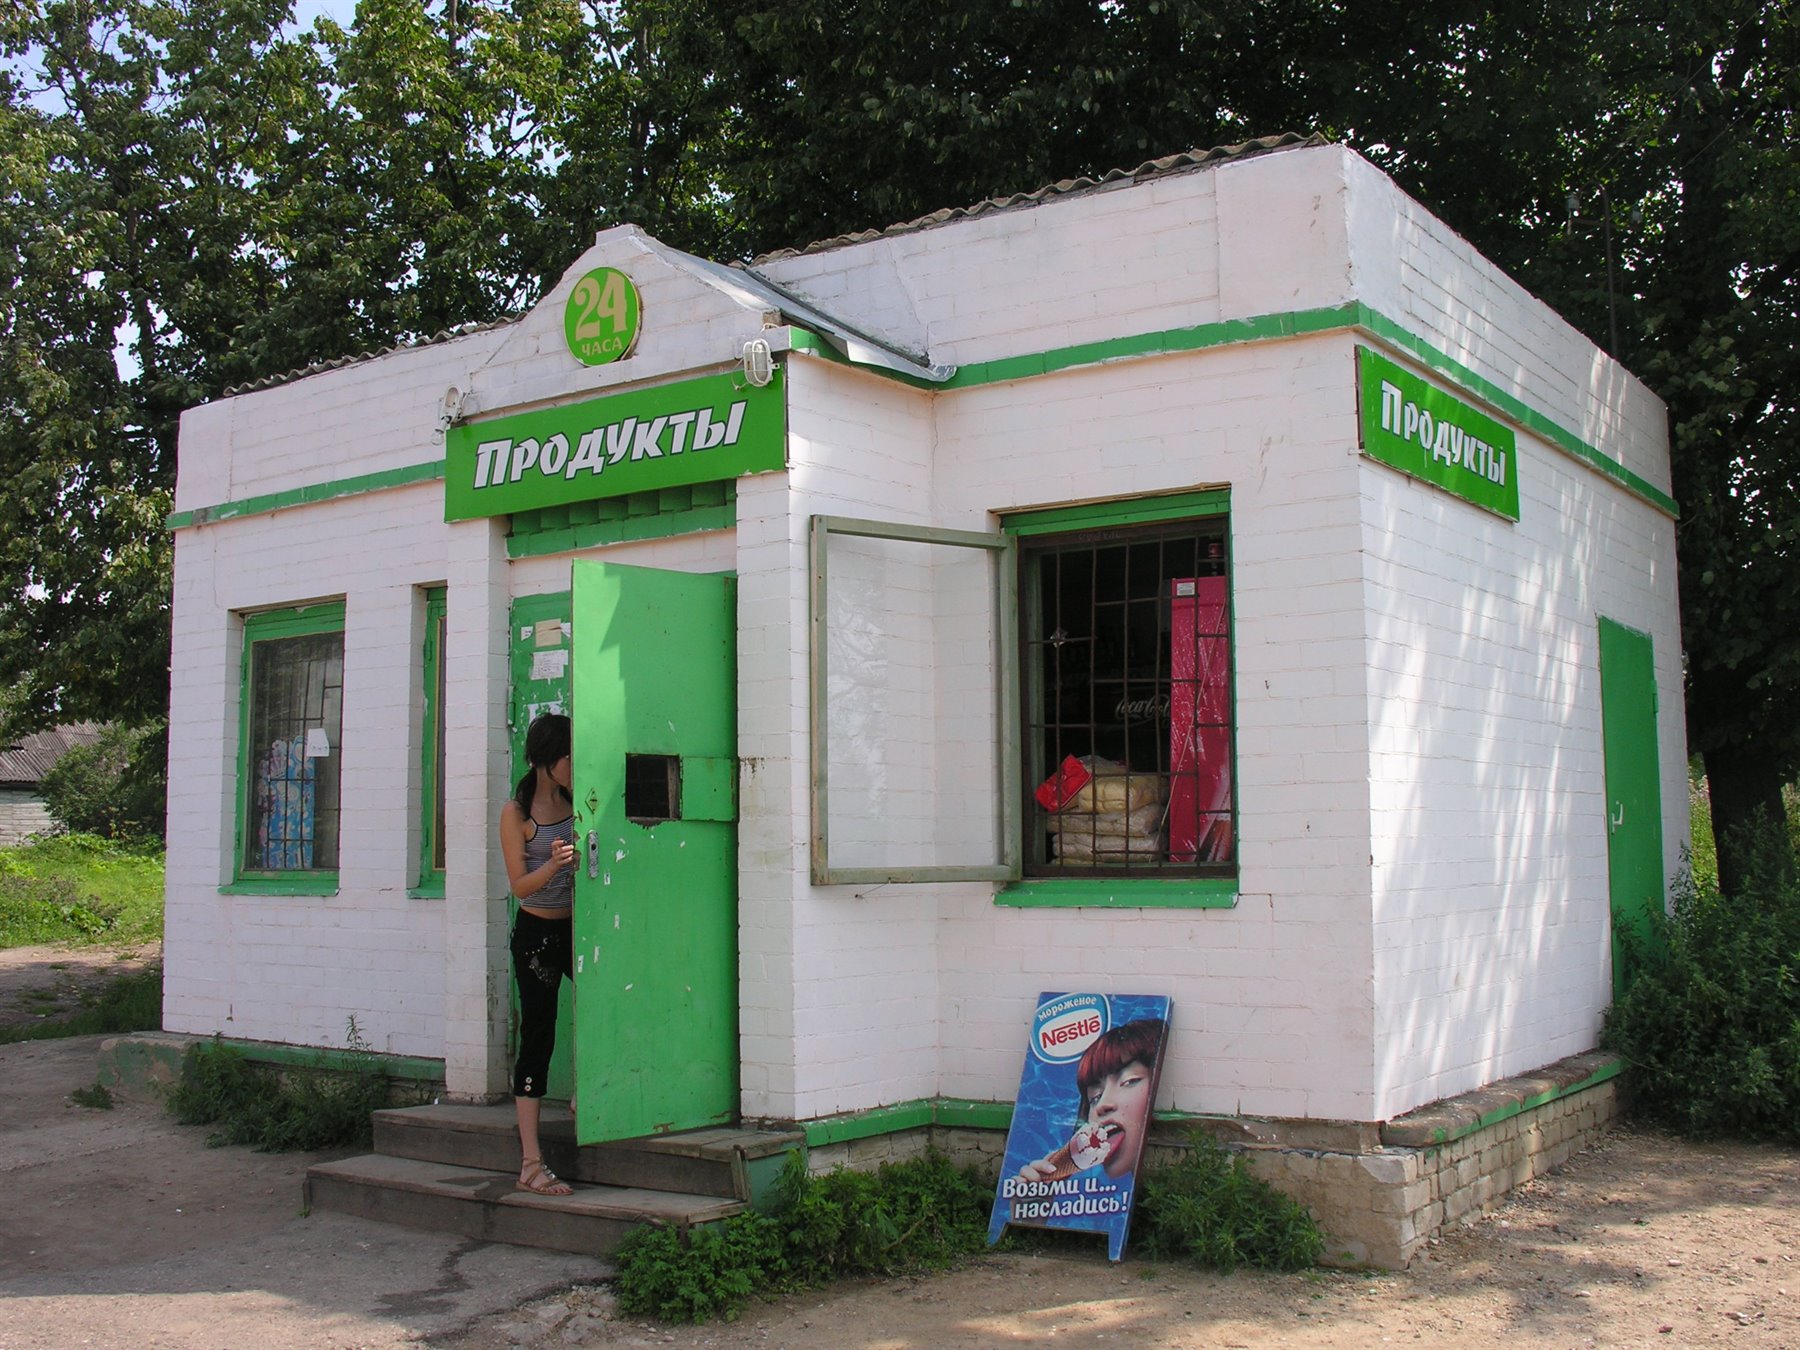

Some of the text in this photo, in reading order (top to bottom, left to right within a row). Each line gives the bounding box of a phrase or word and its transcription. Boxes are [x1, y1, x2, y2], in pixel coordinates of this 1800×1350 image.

[574, 271, 628, 341] 24
[581, 336, 624, 356] ЧАСА
[1038, 995, 1098, 1022] мороженое
[1002, 1178, 1080, 1199] Возьми
[1014, 1191, 1129, 1219] насладись!
